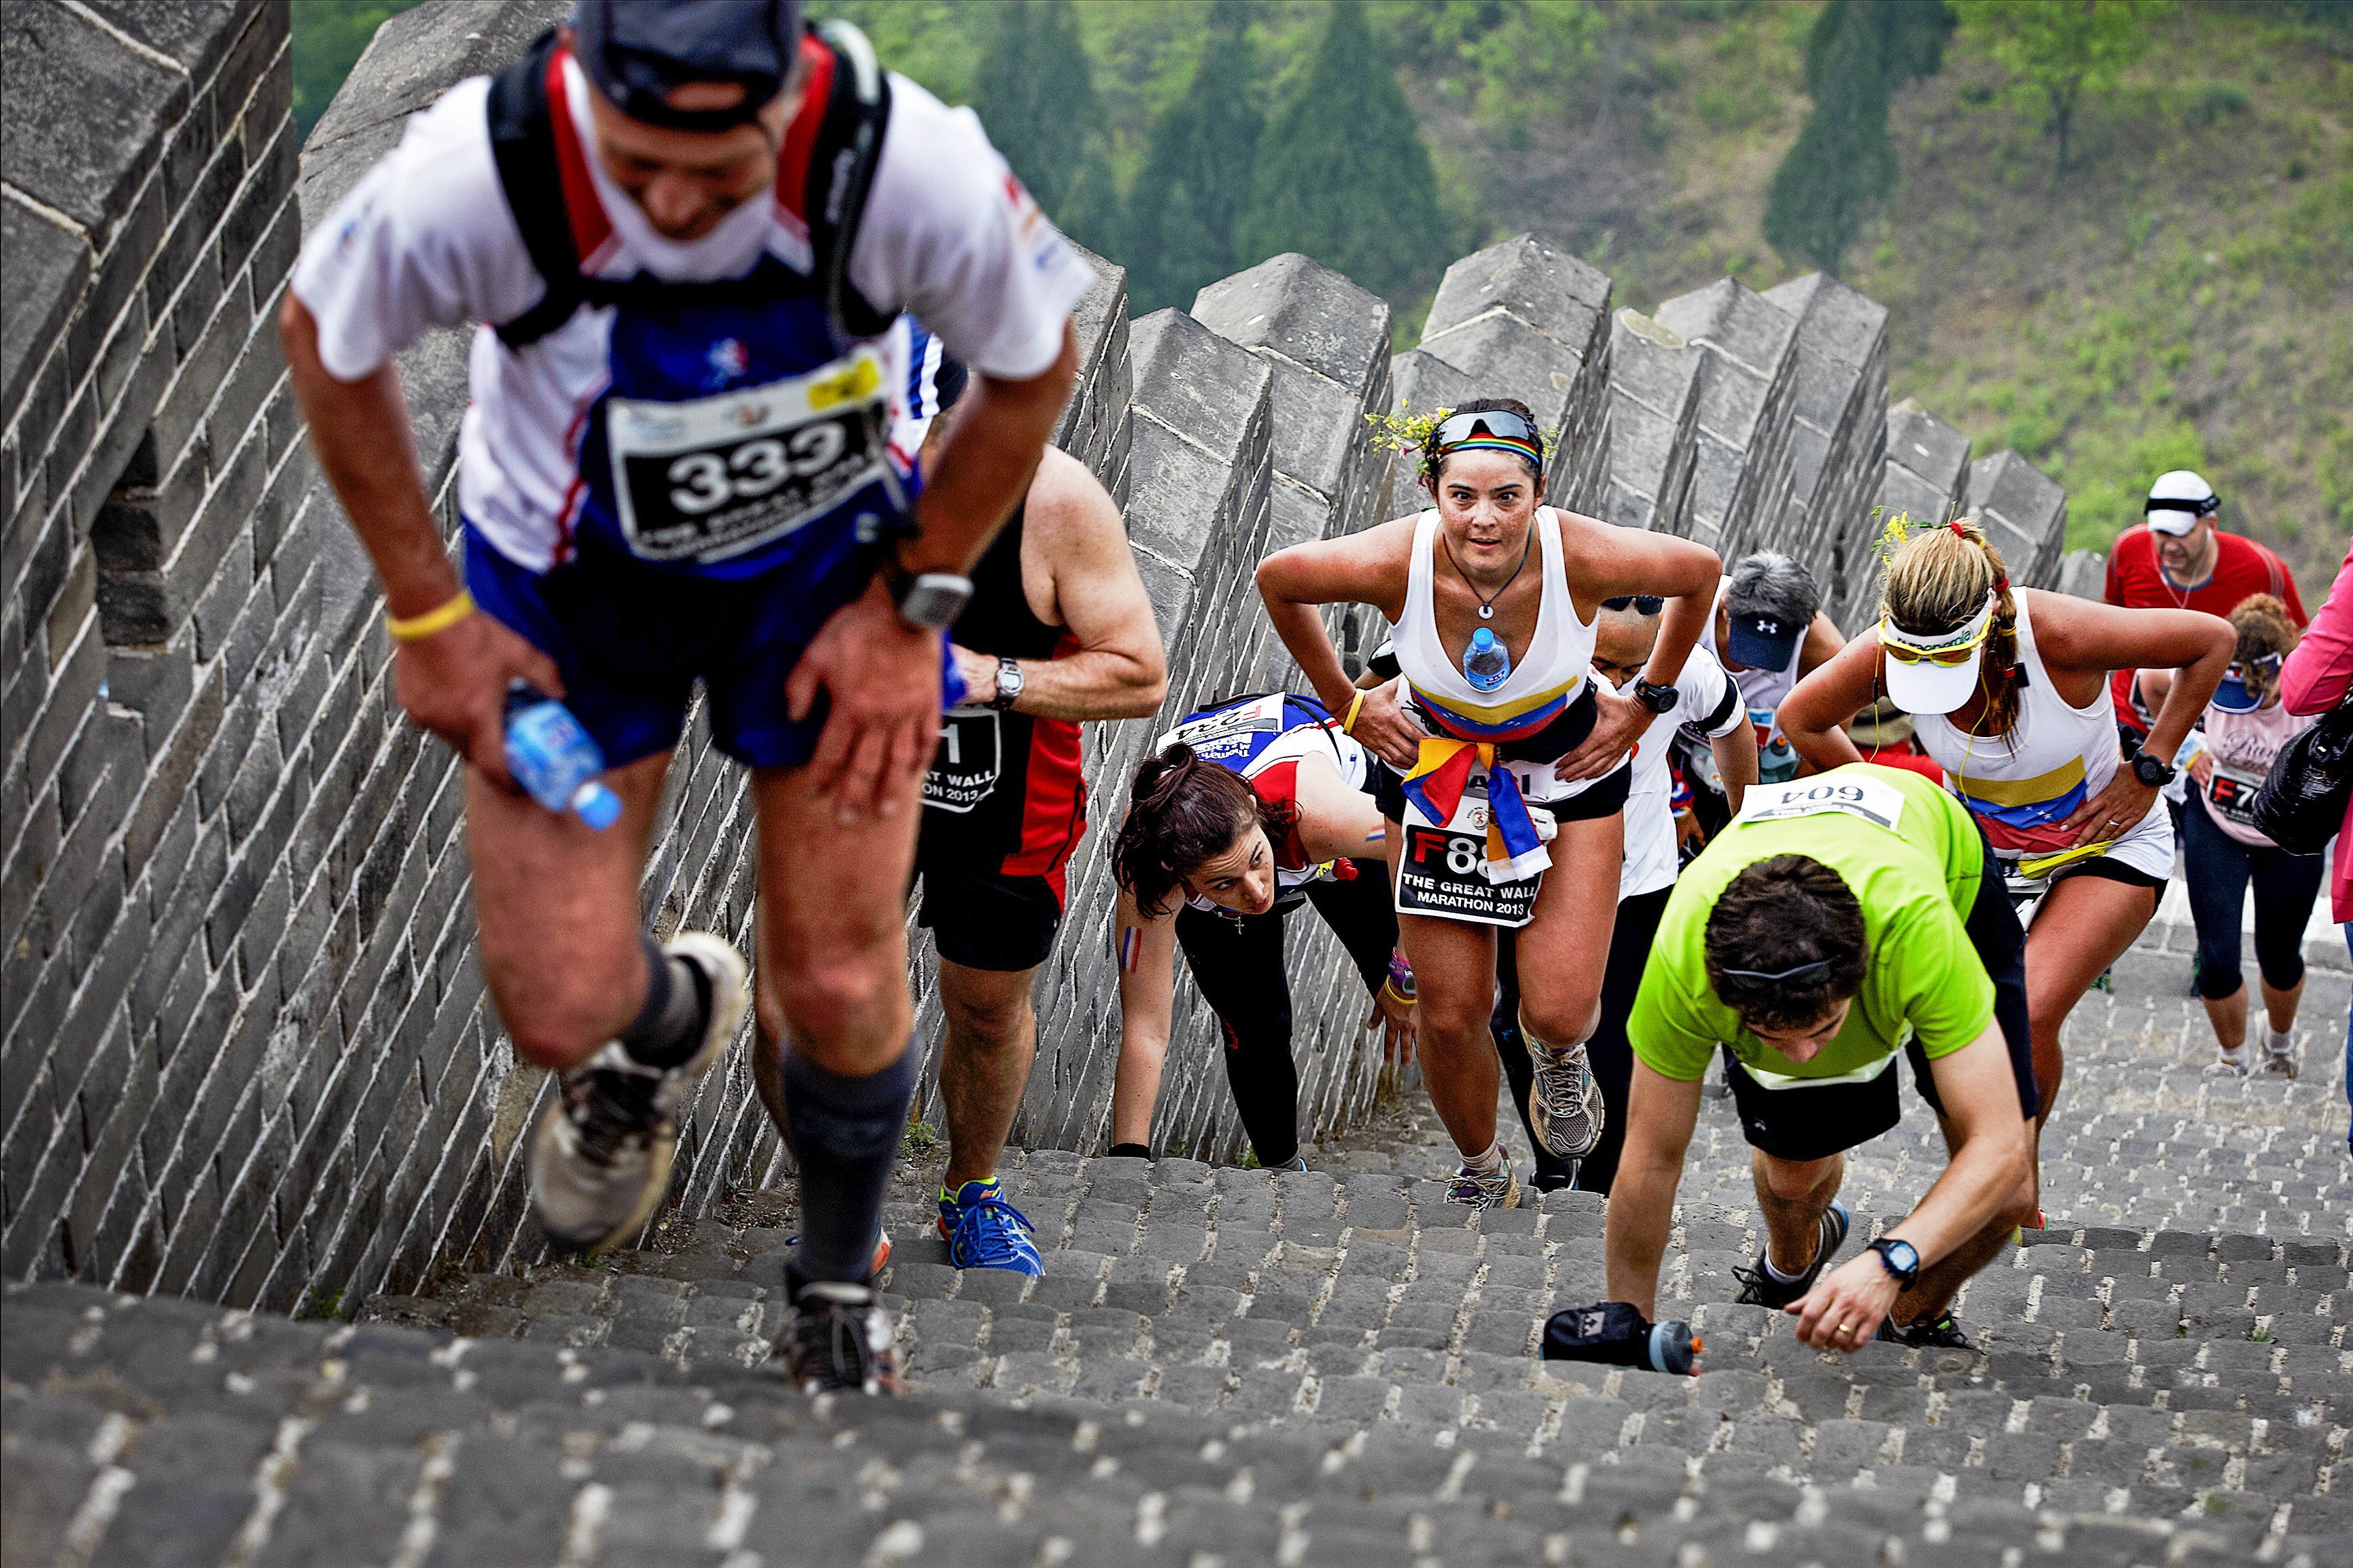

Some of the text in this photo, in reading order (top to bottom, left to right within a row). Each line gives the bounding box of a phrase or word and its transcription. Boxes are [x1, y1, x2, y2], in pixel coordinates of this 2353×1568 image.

[667, 421, 847, 515] 333
[947, 770, 995, 788] WALL
[946, 788, 978, 802] 2013
[1781, 786, 1864, 804] 604
[2214, 778, 2258, 808] F7
[1403, 873, 1535, 899] THE GREAT WALL
[1417, 891, 1493, 912] MARATHON
